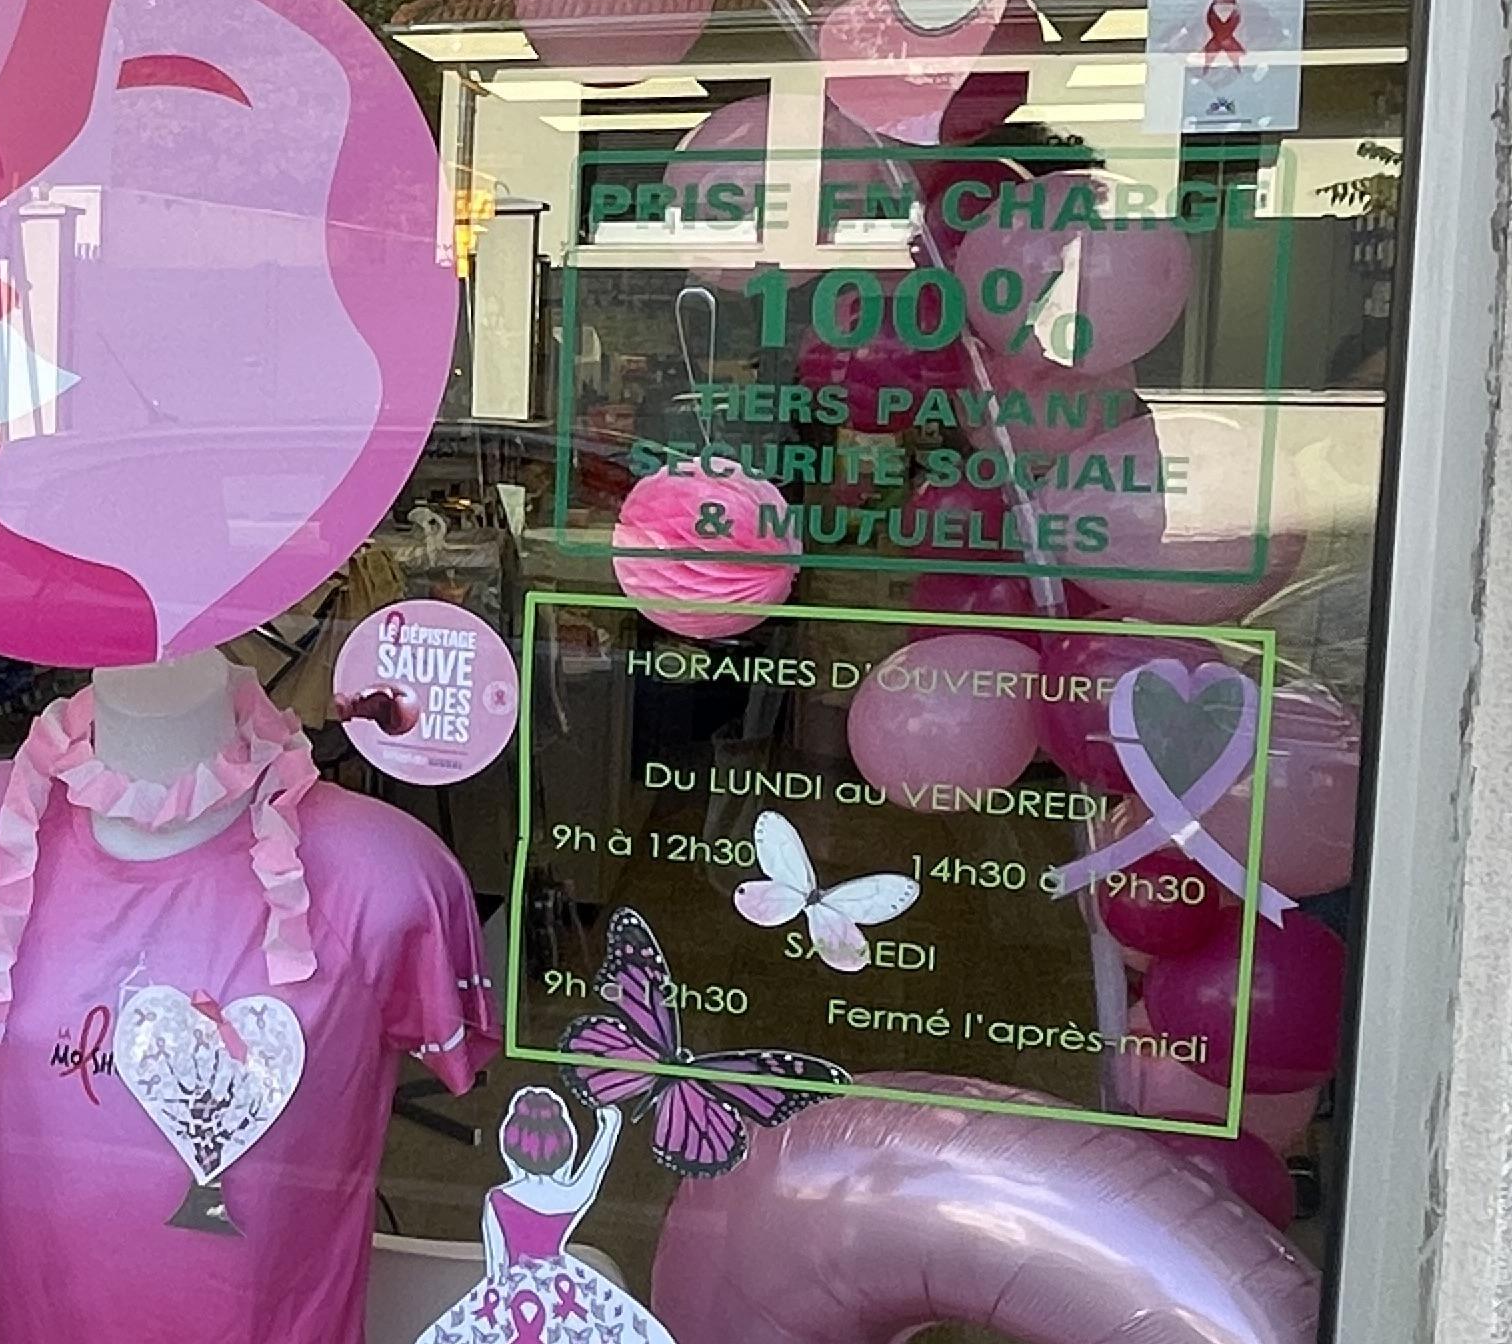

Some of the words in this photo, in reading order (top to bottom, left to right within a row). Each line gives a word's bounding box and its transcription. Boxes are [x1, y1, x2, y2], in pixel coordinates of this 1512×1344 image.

[589, 182, 791, 231] PRISE
[819, 182, 918, 231] EN
[943, 179, 1257, 234] CHARGE
[697, 383, 849, 425] TIERS
[878, 386, 1135, 430] PAYANT
[927, 447, 1190, 495] SOCIALE
[694, 502, 735, 540] &
[757, 502, 1110, 554] MUTUELLES
[378, 623, 397, 642] LE
[400, 623, 477, 650] DÉPISTAGE
[377, 643, 476, 687] SAUVE
[627, 650, 817, 688] HORAIRES
[430, 686, 472, 715] DES
[419, 712, 470, 743] VIES
[645, 762, 697, 792] Du
[710, 766, 823, 800] LUNDI
[834, 780, 887, 807] au
[902, 782, 1108, 822] VENDREDI
[552, 824, 597, 852] 9h
[608, 827, 632, 857] à
[650, 831, 756, 868] 12h30
[911, 854, 1026, 891] 14h30
[544, 971, 586, 999] 9h
[828, 999, 951, 1037] Fermé
[963, 1013, 1209, 1065] l'après-midi
